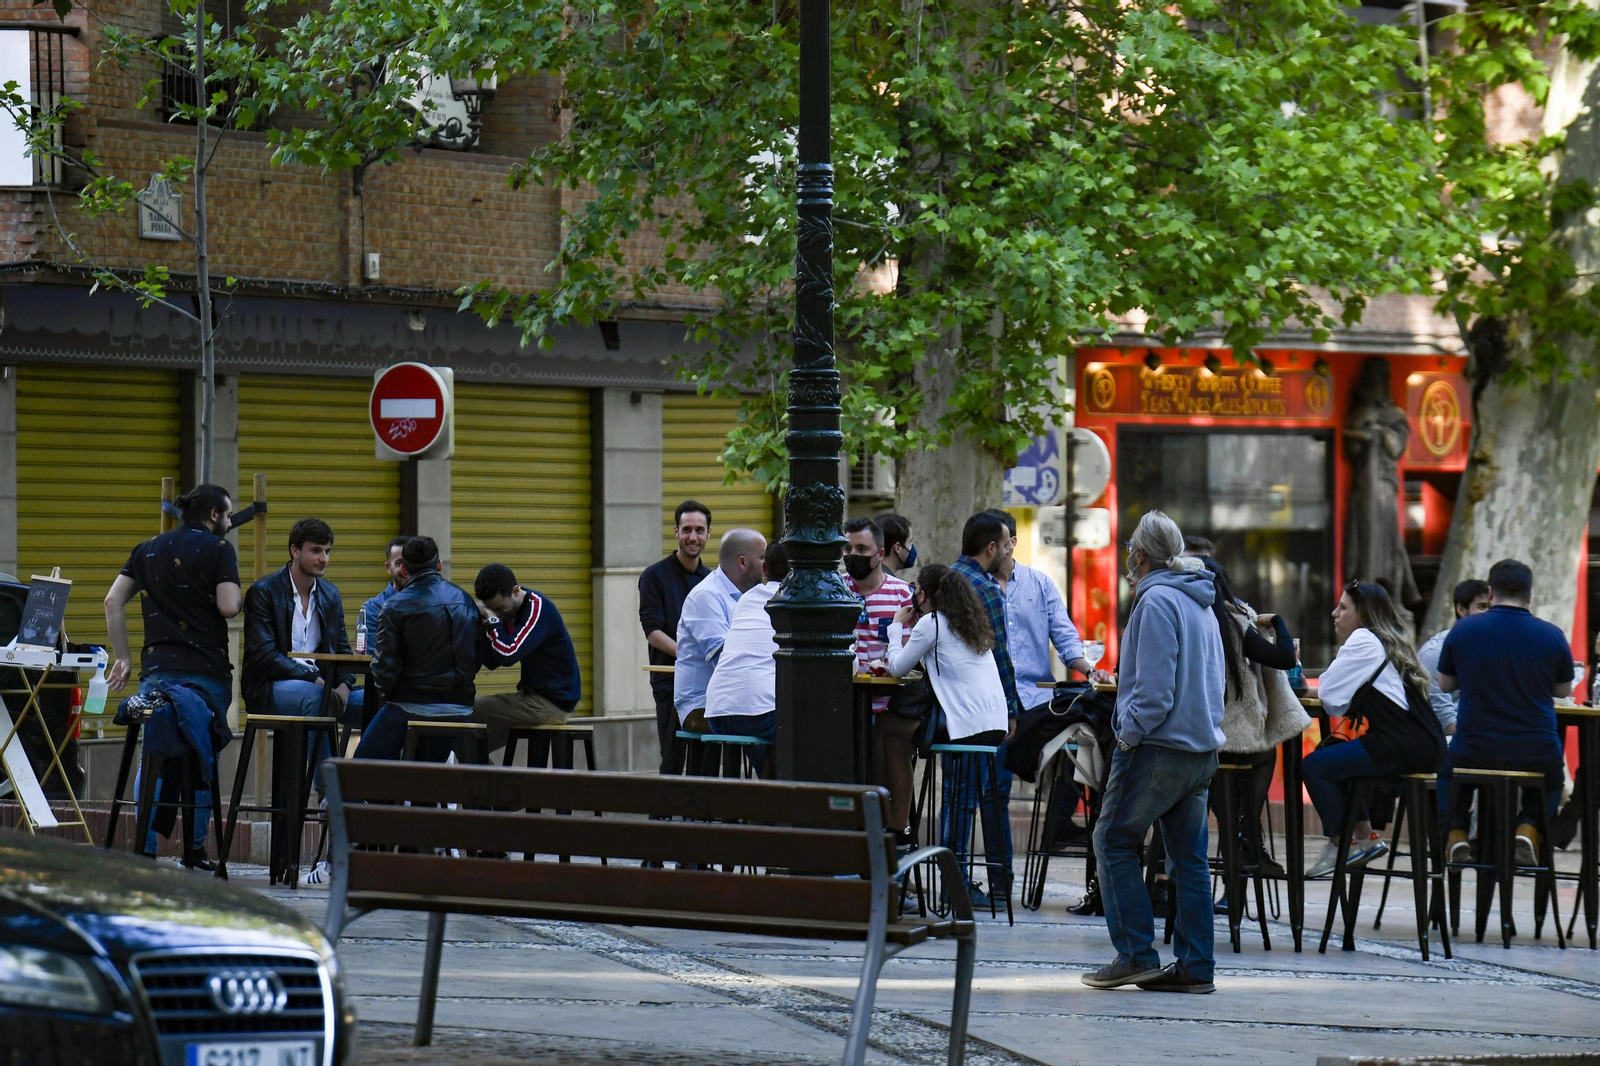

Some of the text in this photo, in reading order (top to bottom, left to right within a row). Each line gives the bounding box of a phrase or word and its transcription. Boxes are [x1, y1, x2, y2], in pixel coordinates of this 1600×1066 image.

[153, 198, 169, 206] PLAZA
[151, 222, 172, 232] PINEDA
[109, 307, 146, 348] LA
